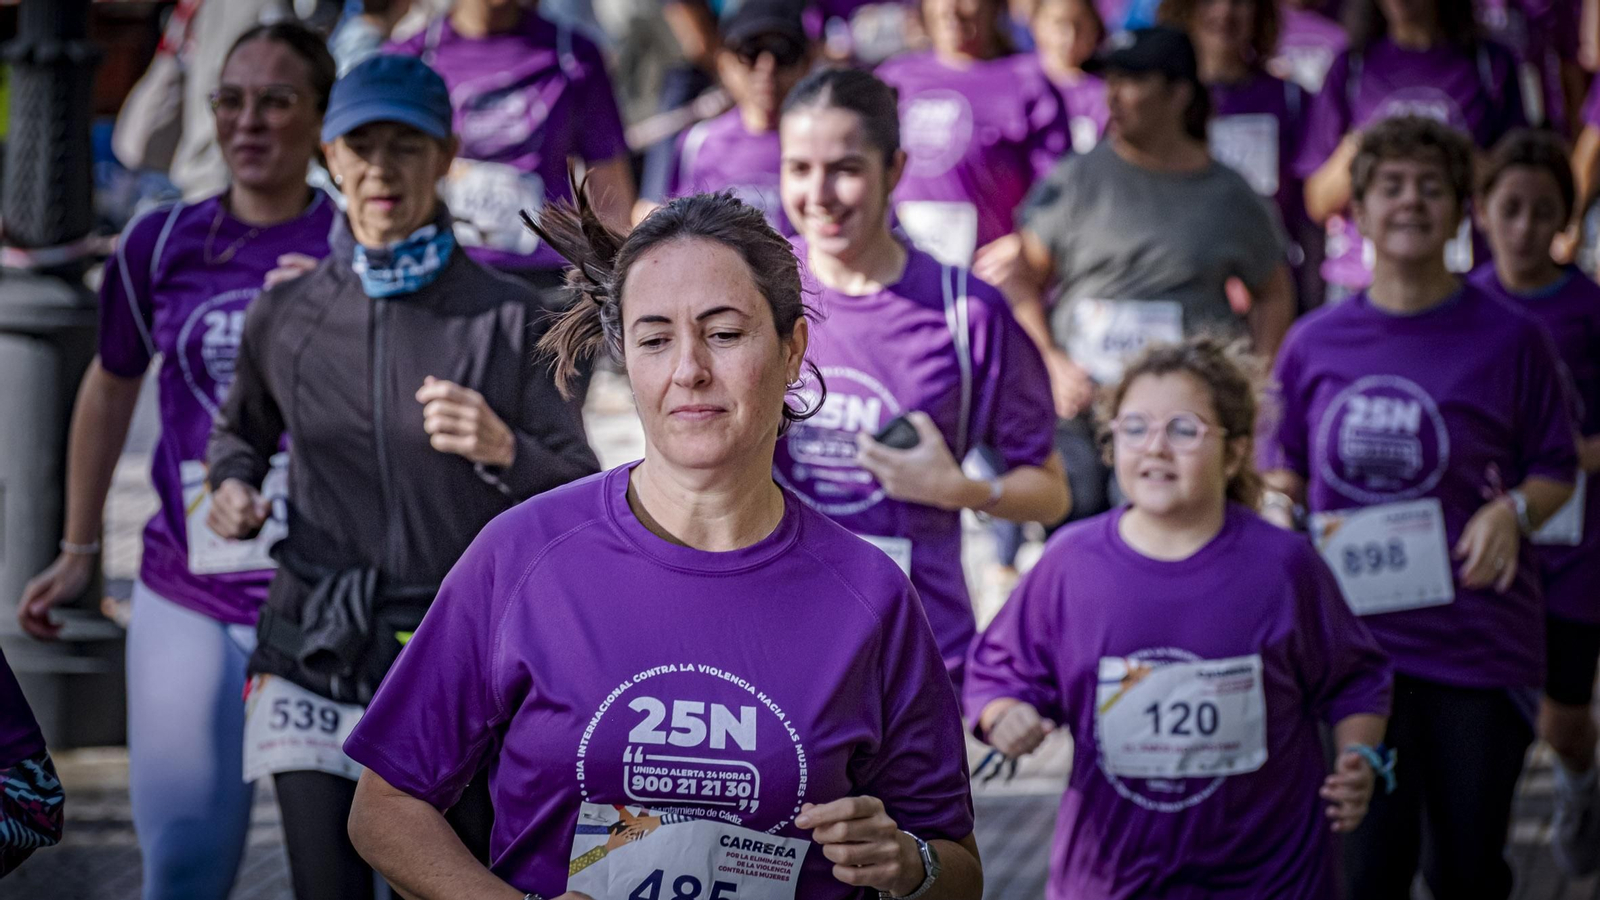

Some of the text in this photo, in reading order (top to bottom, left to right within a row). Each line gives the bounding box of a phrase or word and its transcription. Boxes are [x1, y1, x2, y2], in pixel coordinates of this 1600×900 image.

[269, 698, 340, 735] 539
[628, 696, 756, 751] 25N
[1145, 701, 1219, 736] 120
[577, 680, 633, 757] INTERNACIONAL
[633, 664, 677, 683] CONTRA
[680, 663, 695, 671] LA
[698, 664, 755, 694] VIOLENCIA
[757, 692, 785, 721] HACIA
[783, 721, 800, 742] LAS
[795, 744, 808, 797] MUJERES
[633, 766, 752, 780] UNIDAD ALERTA 24 HORAS
[632, 775, 752, 798] 900 21 21 30
[706, 807, 718, 817] de
[718, 810, 743, 826] Cádiz
[720, 835, 796, 859] CARRERA
[750, 855, 794, 867] ELIMINACIÓN
[756, 864, 791, 874] VIOLENCIA
[718, 866, 745, 875] CONTRA
[759, 872, 790, 882] MUJERES
